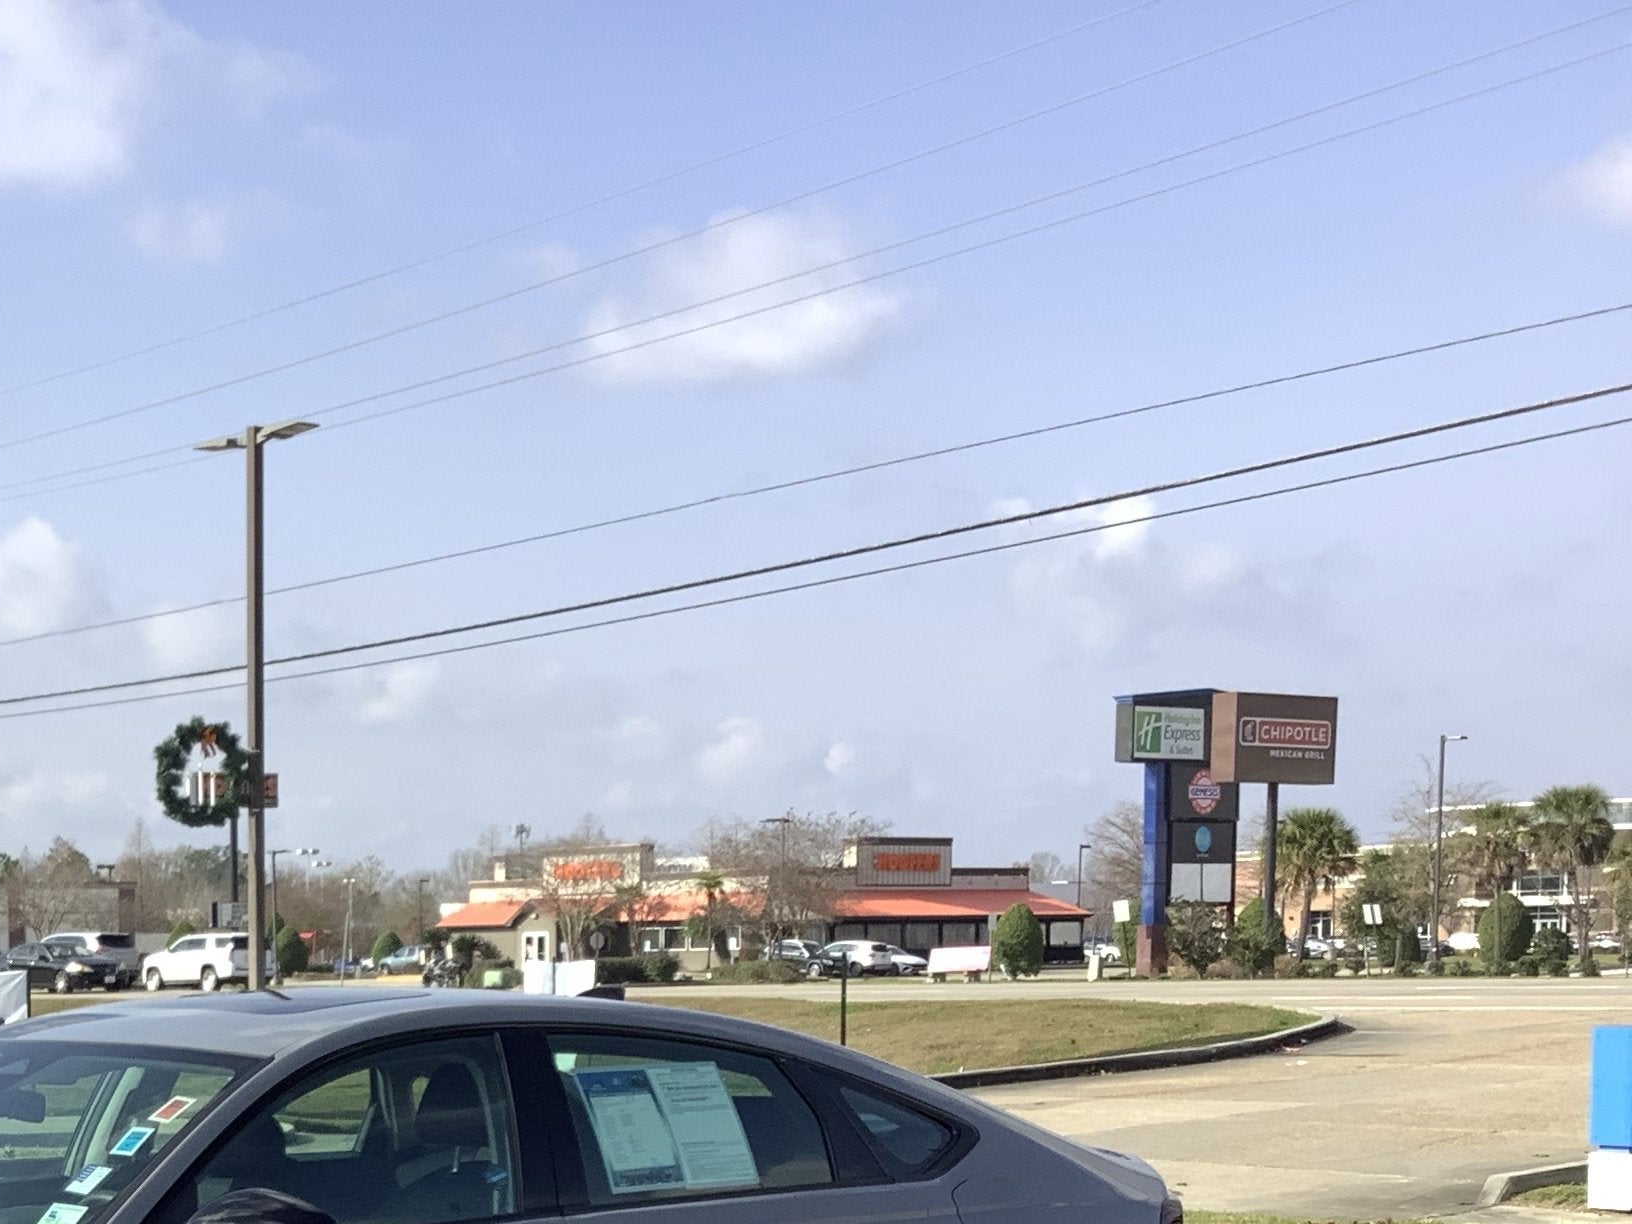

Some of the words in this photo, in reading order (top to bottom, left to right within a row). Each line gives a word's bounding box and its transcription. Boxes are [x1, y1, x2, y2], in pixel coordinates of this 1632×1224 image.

[1164, 725, 1202, 743] Express
[1261, 725, 1326, 742] CHIPOTLE
[1269, 749, 1303, 758] MEXICAN
[1304, 751, 1325, 760] GRILL
[1190, 787, 1219, 797] GENESIS
